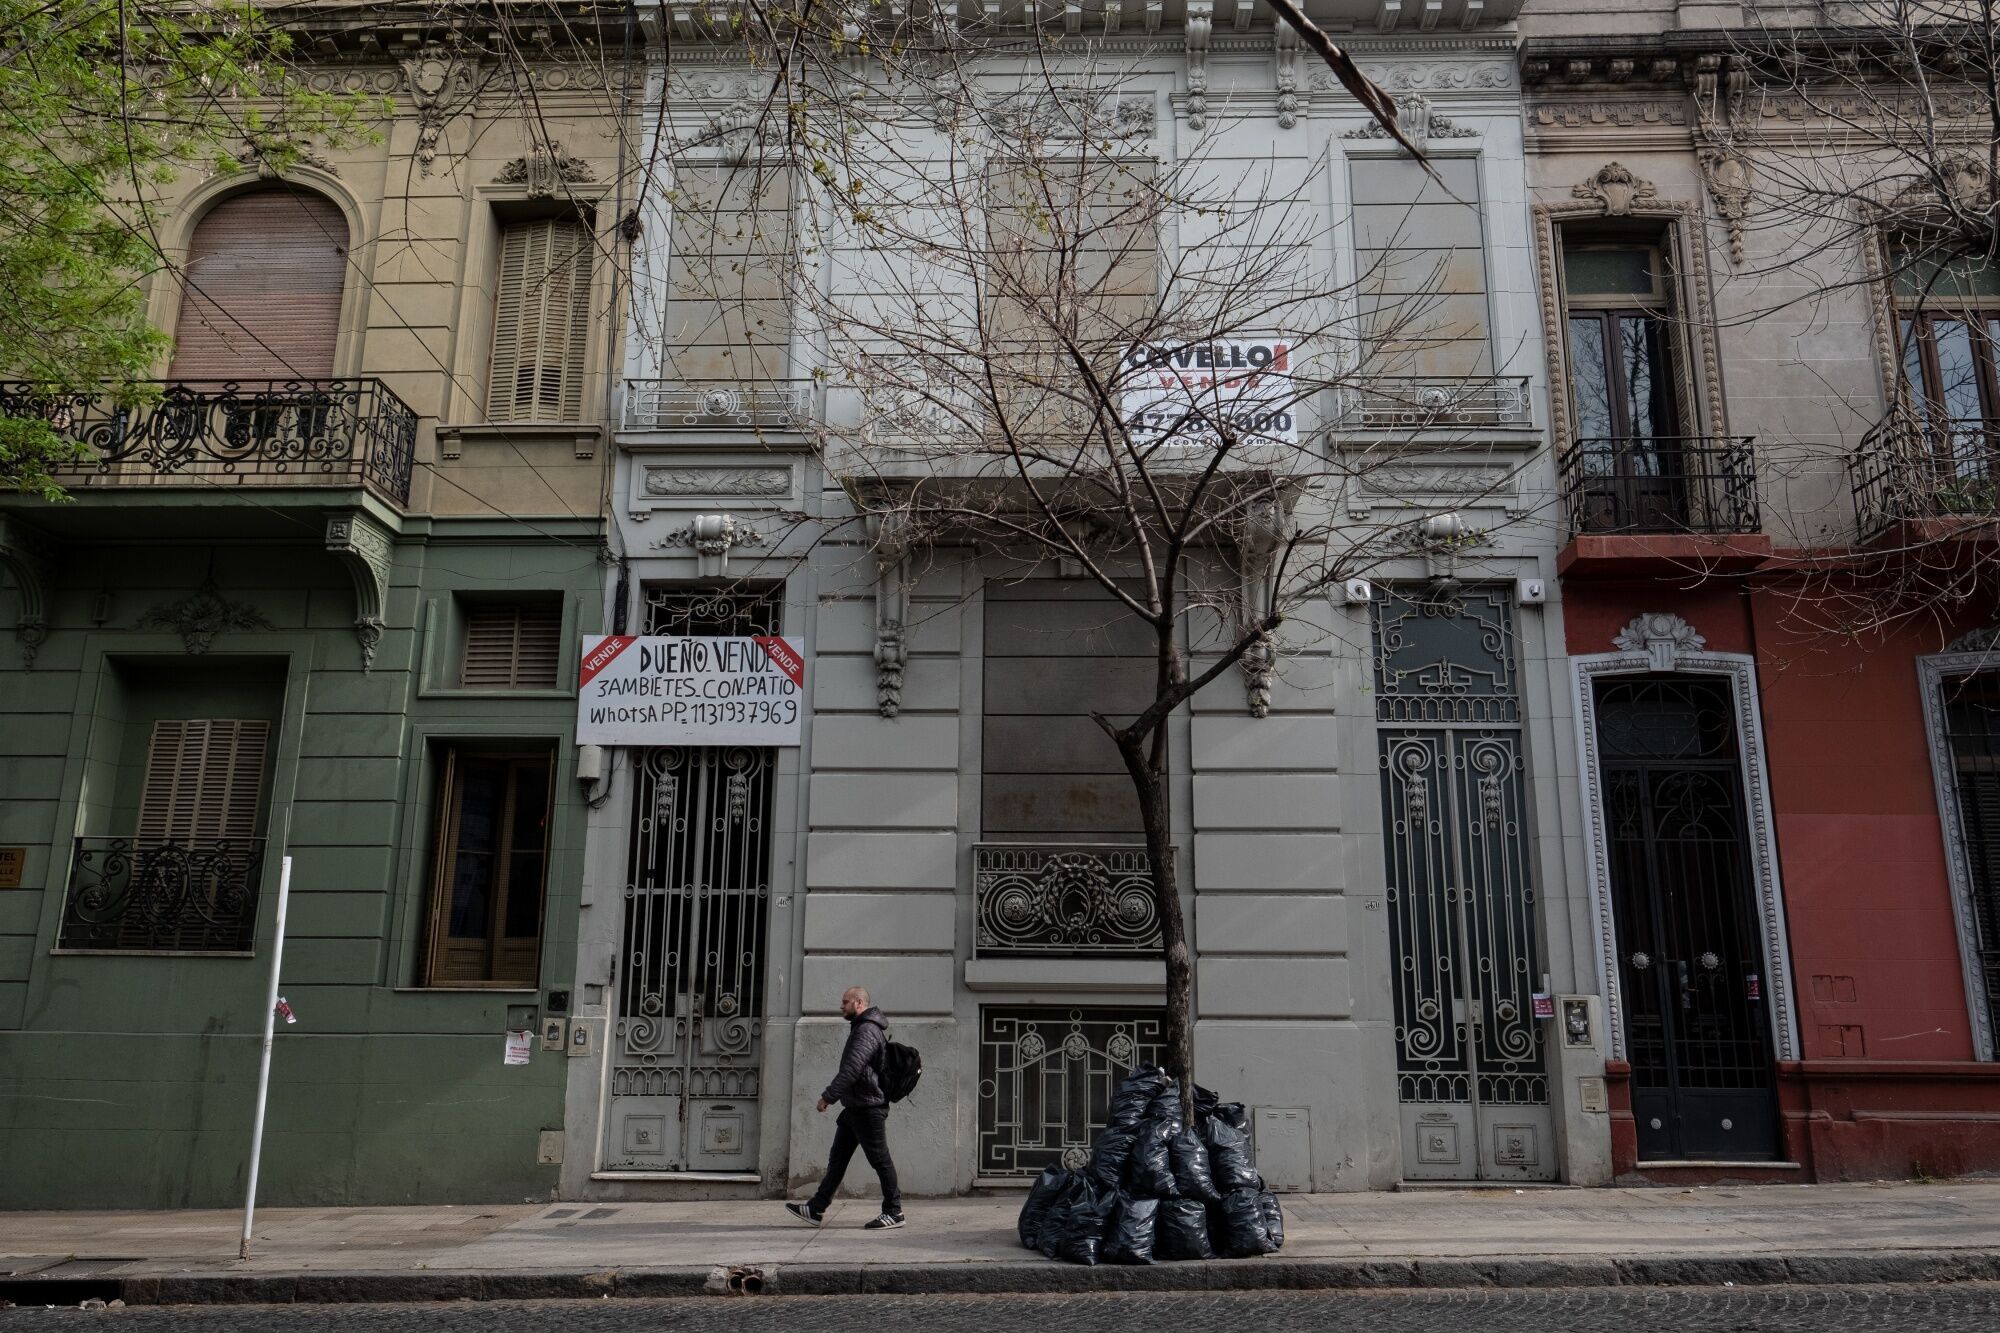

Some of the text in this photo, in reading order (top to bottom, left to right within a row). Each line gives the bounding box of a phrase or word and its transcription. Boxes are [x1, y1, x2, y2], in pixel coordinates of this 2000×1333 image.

[1127, 345, 1273, 369] COVELLO
[1159, 376, 1260, 389] VENDE
[585, 638, 622, 672] VENDE
[713, 641, 773, 673] VENDE
[768, 640, 800, 675] VENDE
